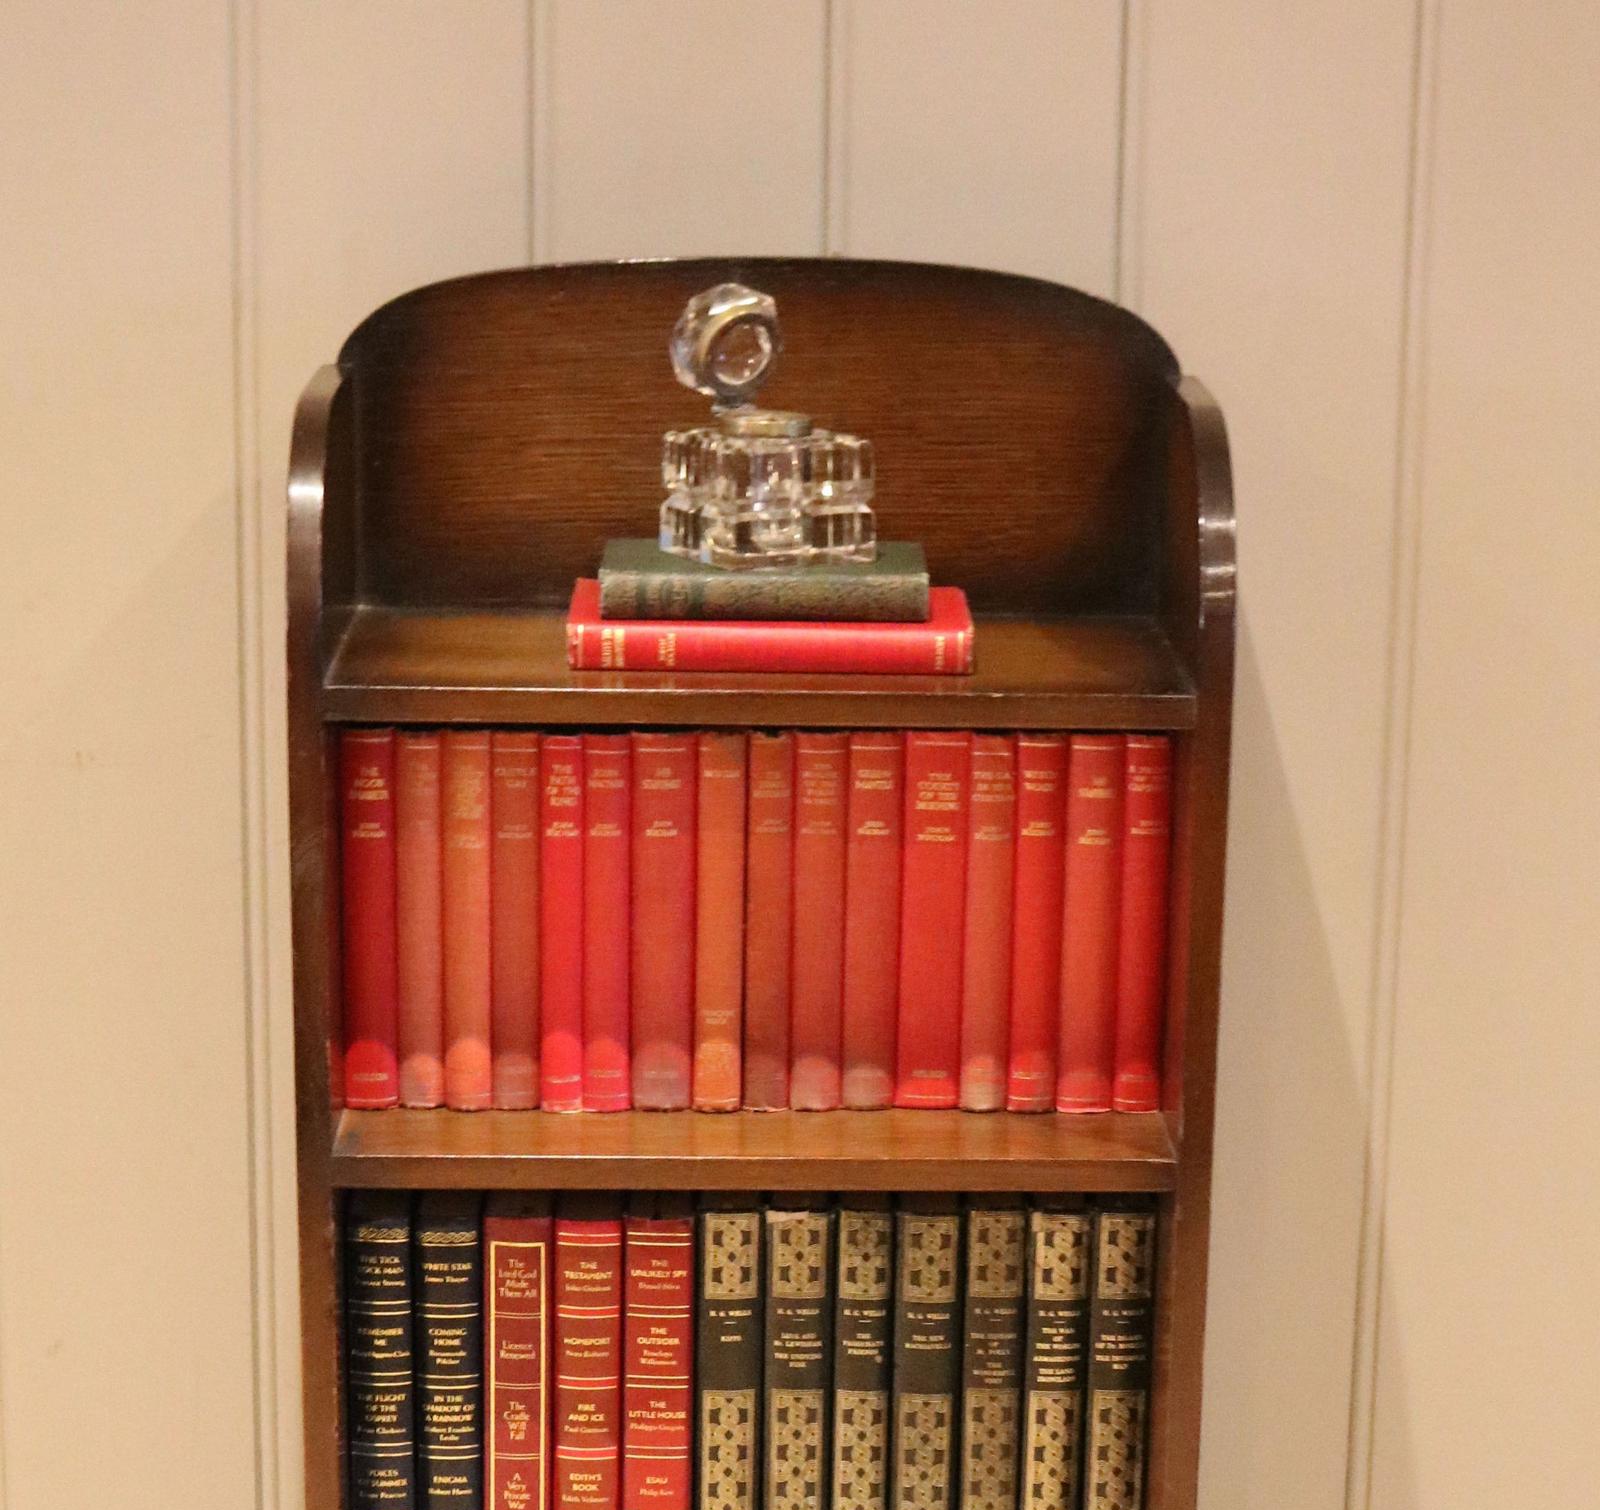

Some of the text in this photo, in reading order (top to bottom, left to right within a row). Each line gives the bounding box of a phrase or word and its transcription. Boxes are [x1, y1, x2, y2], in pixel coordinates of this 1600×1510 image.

[508, 1259, 525, 1268] The
[509, 1402, 526, 1410] The
[510, 1430, 525, 1440] Fall
[507, 1482, 526, 1492] Very
[508, 1501, 525, 1510] War
